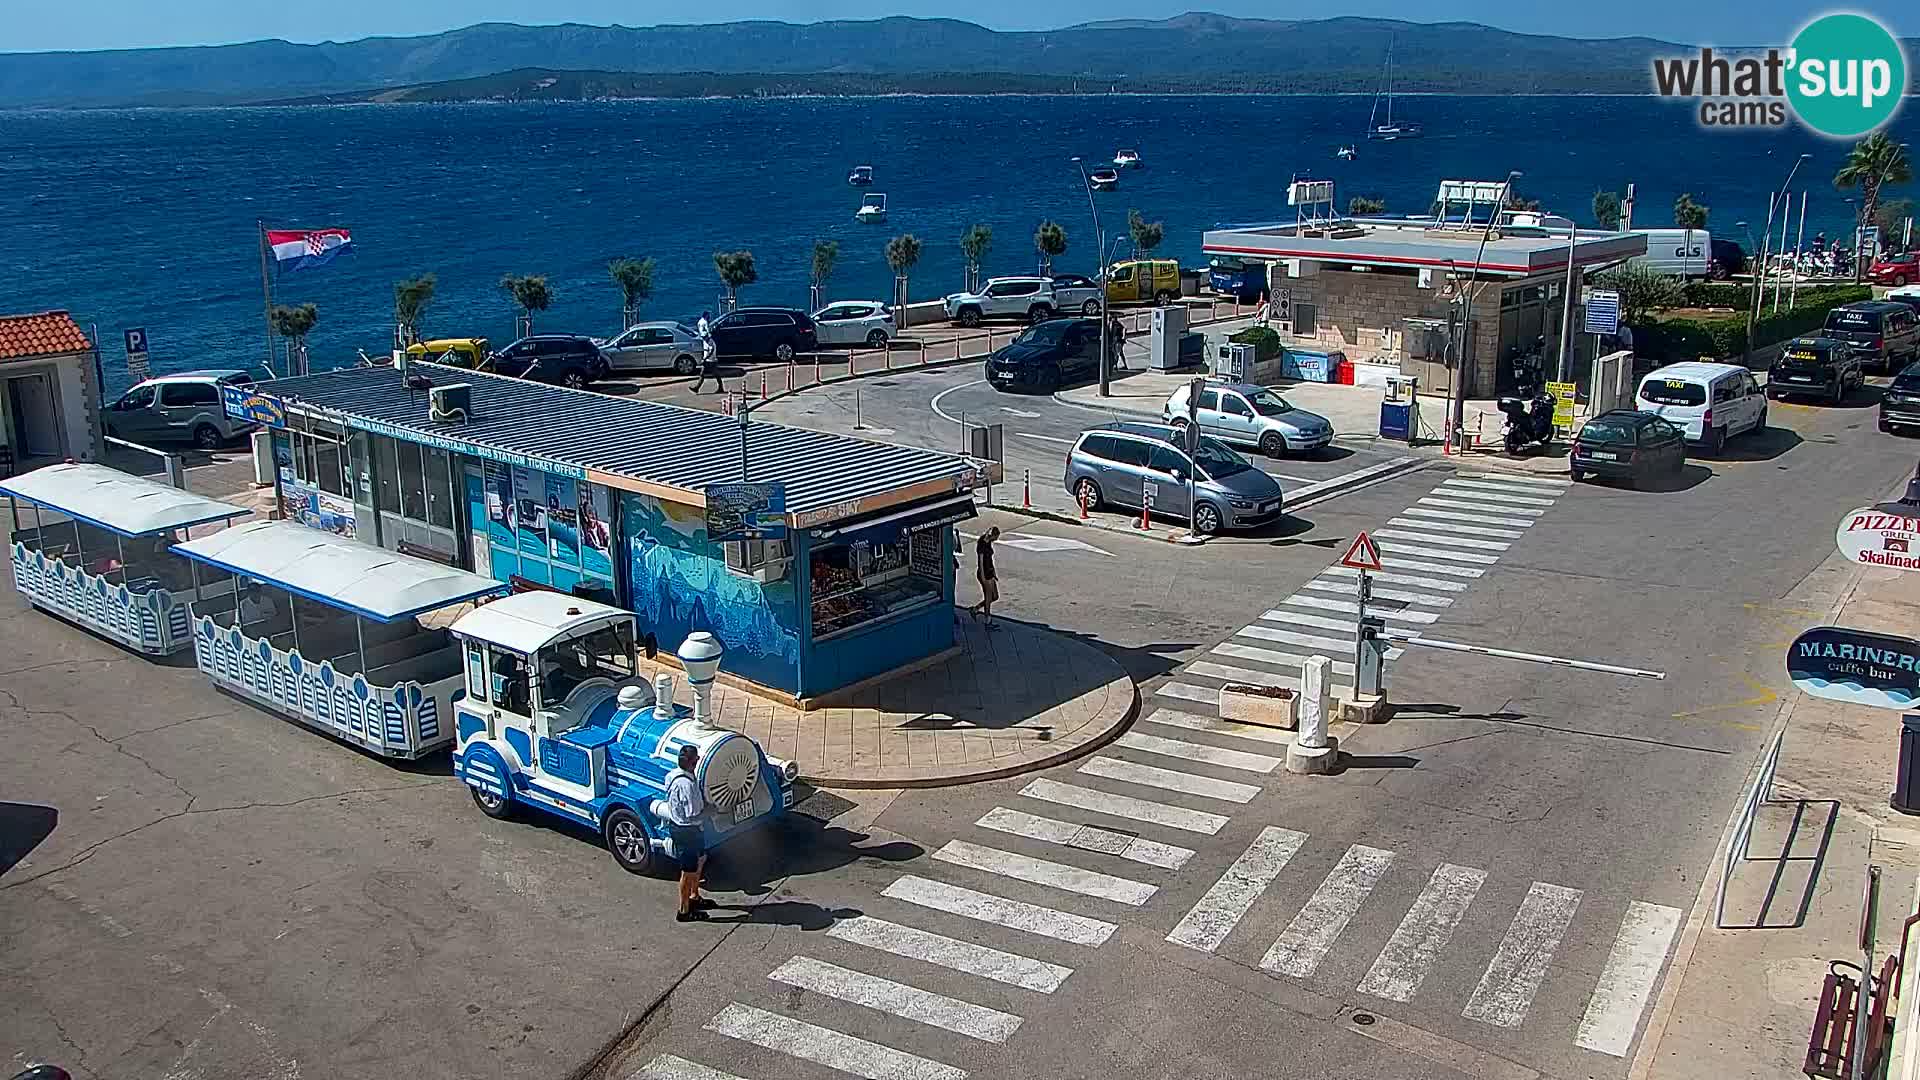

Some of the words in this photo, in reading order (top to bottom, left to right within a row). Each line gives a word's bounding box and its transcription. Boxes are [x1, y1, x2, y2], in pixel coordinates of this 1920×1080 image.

[1675, 247, 1700, 258] GLS
[128, 331, 141, 350] P
[1666, 381, 1684, 389] TAXI
[478, 446, 492, 458] BUS
[493, 449, 525, 465] STATION
[528, 457, 553, 472] TICKET
[554, 462, 581, 478] OFFICE
[1880, 530, 1916, 541] GRILL
[1828, 661, 1864, 675] caffe
[1869, 665, 1896, 681] bar
